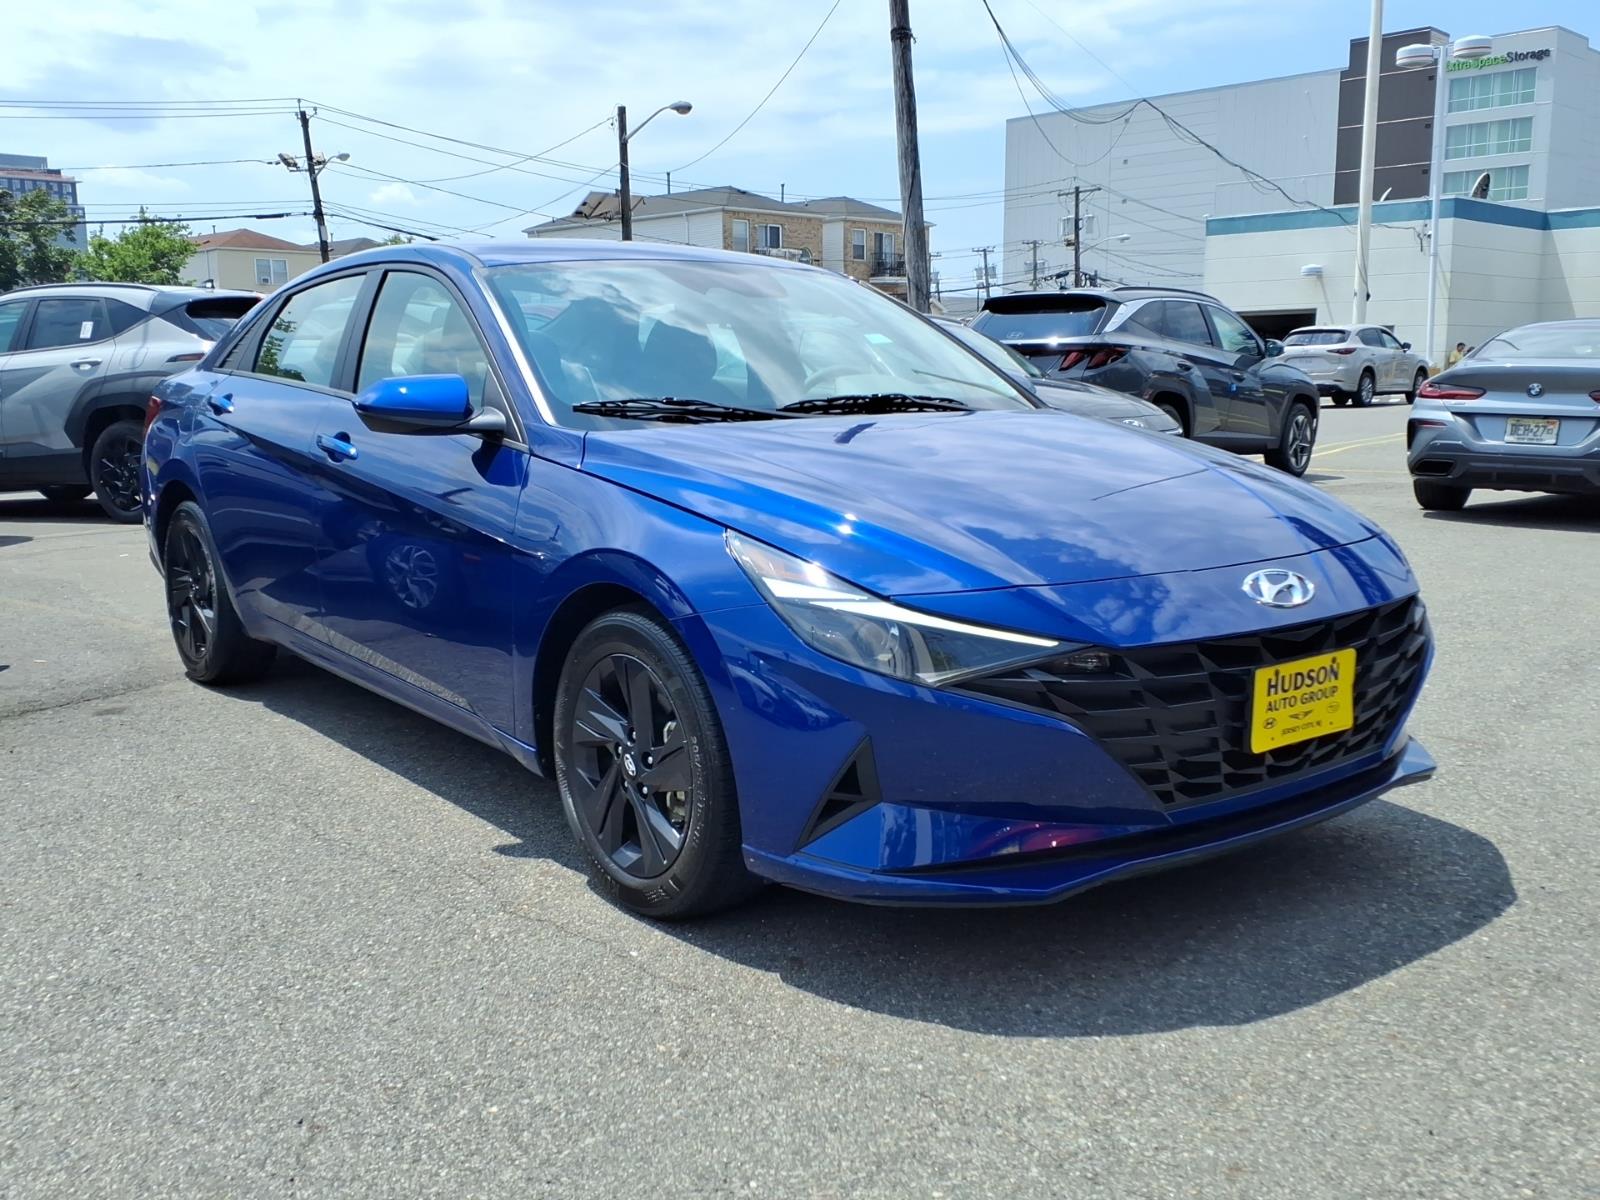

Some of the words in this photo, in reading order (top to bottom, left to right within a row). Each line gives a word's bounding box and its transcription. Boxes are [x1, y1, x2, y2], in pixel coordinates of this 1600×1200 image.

[1267, 658, 1340, 697] HUDSON
[1266, 695, 1297, 712] AUTO
[1300, 685, 1338, 704] GROUP
